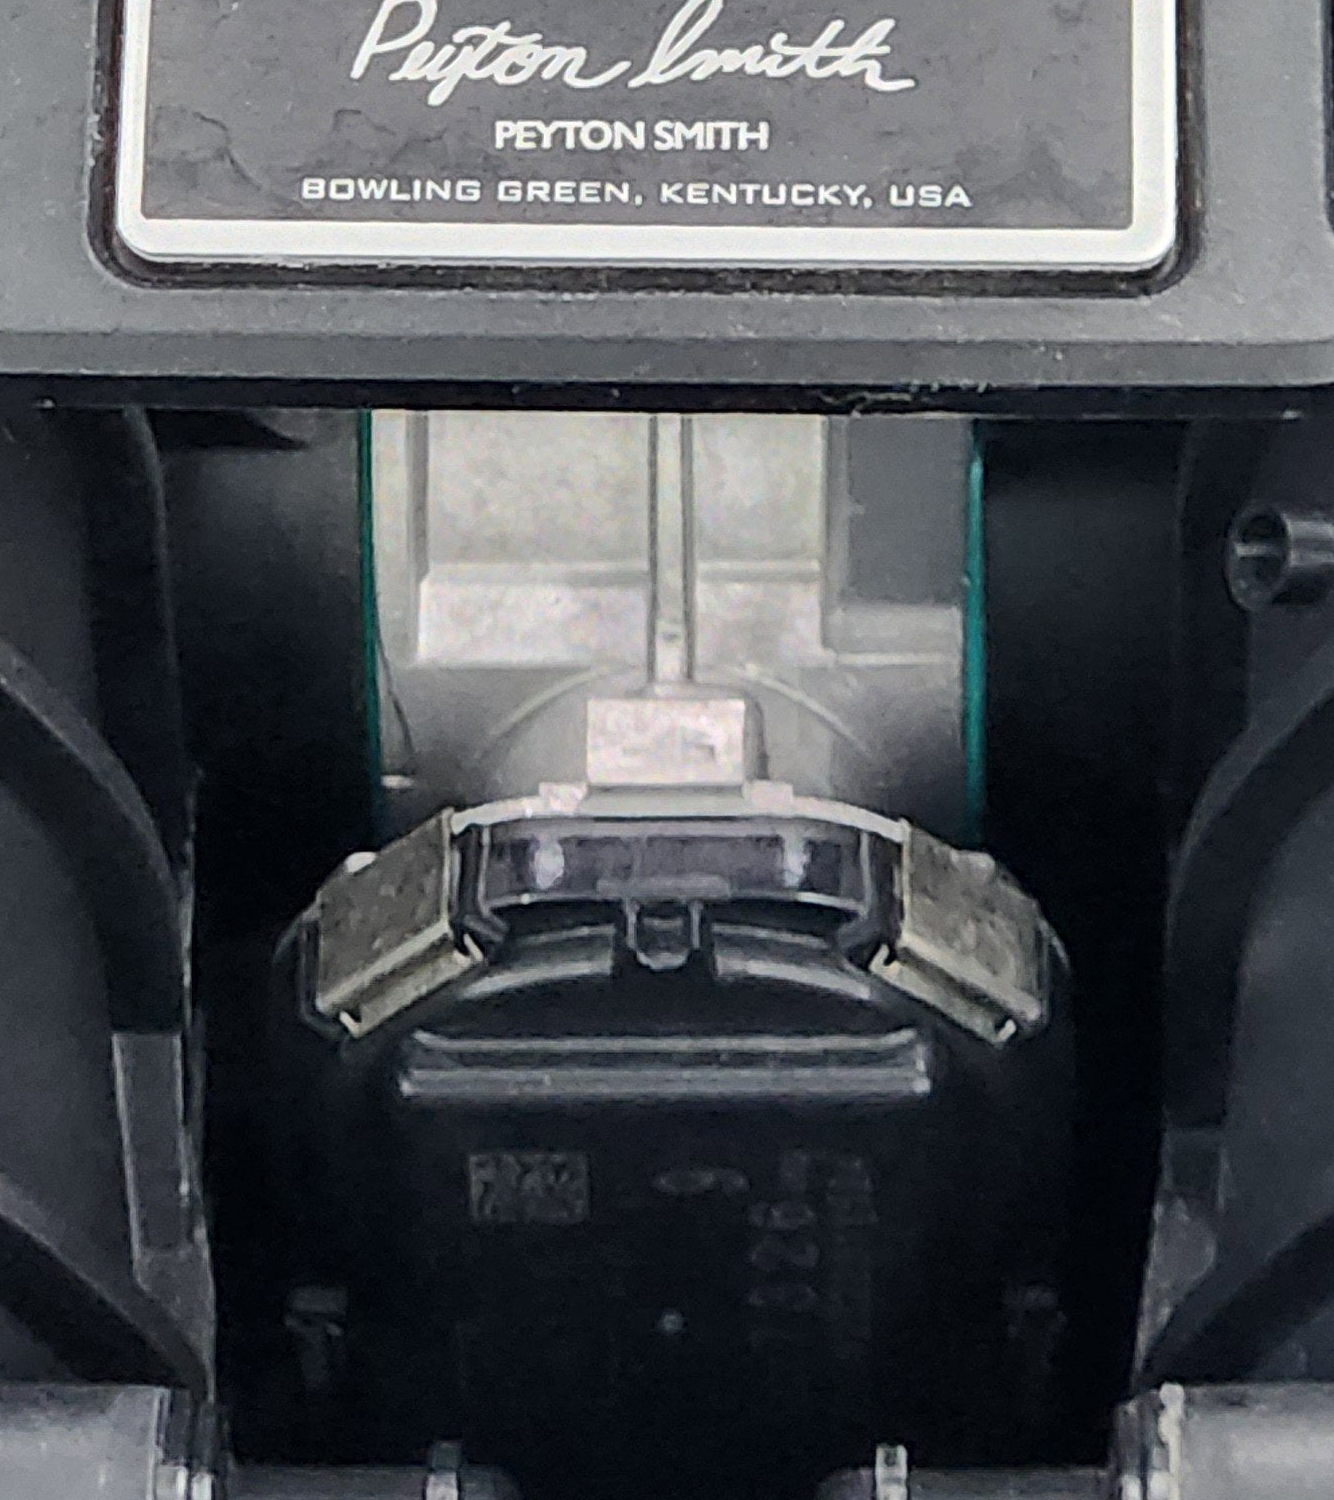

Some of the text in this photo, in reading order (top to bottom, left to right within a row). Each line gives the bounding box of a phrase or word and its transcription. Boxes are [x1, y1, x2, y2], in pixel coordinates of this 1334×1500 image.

[494, 119, 770, 151] PEYTON SMITH
[300, 177, 973, 210] BOWLING GREEN, KENTUCKY, USA
